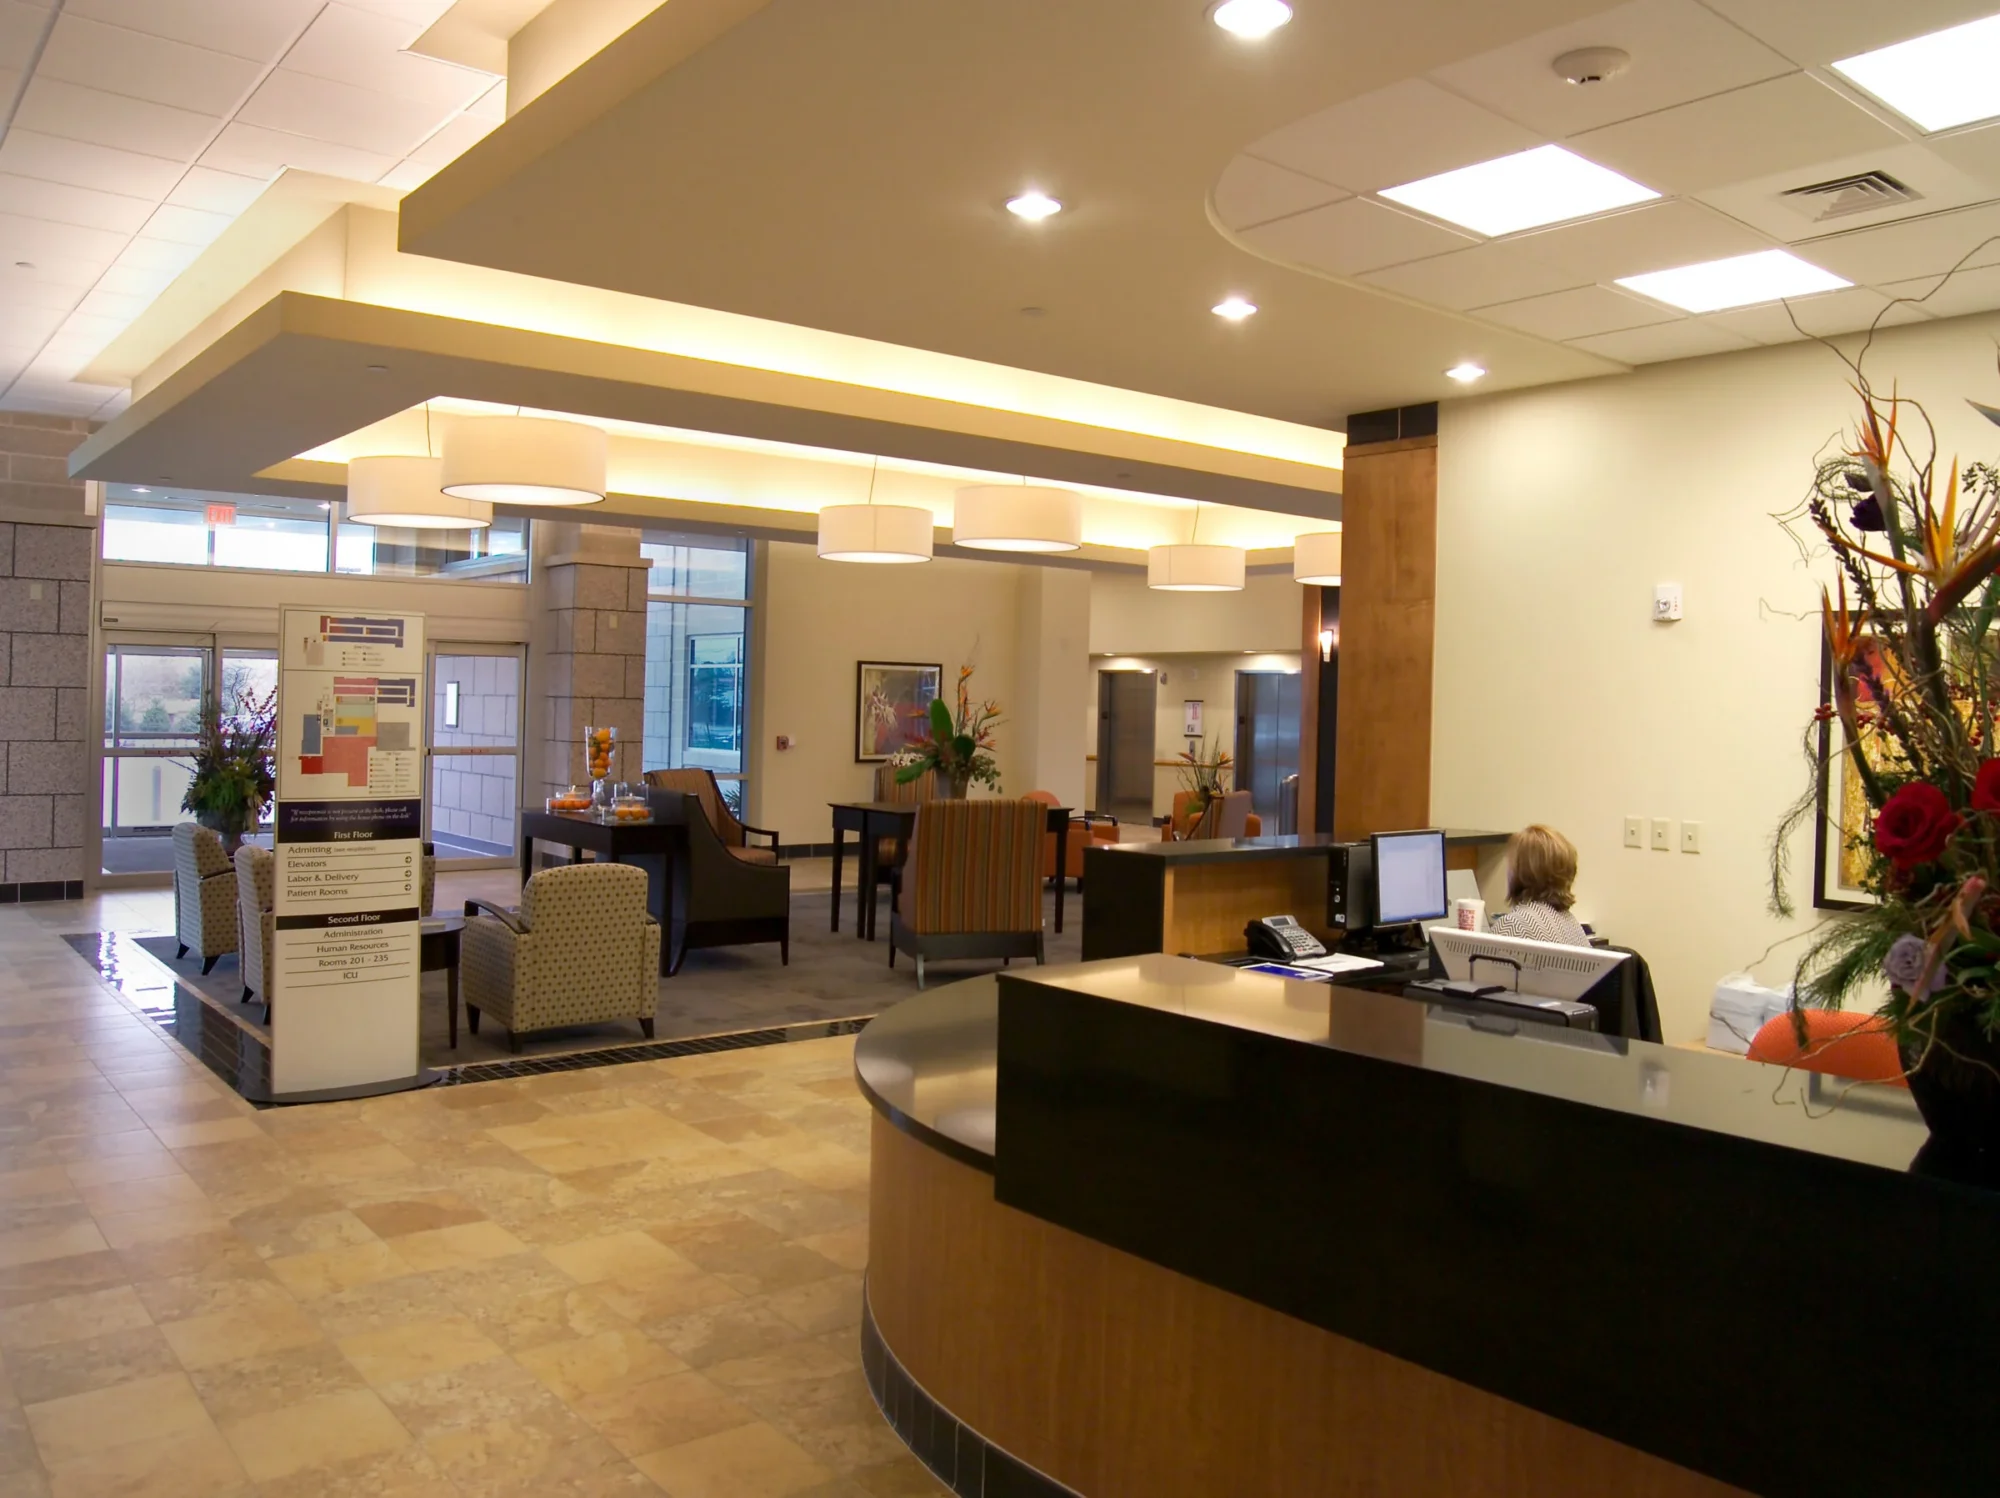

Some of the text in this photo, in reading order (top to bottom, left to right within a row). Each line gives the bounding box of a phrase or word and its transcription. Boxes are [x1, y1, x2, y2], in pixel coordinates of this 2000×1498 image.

[208, 504, 235, 524] EXIT
[333, 830, 373, 839] First Floor
[287, 846, 332, 854] Admitting
[287, 860, 327, 868] Elevators
[287, 873, 359, 883] Labor & Delivery
[287, 888, 349, 897] Patient Rooms
[327, 914, 381, 924] Second Floor
[323, 928, 383, 938] Administration
[316, 942, 389, 953] Human Resources
[318, 959, 347, 967] Rooms
[350, 956, 365, 964] 201
[373, 954, 389, 963] 235
[343, 971, 359, 980] ICU
